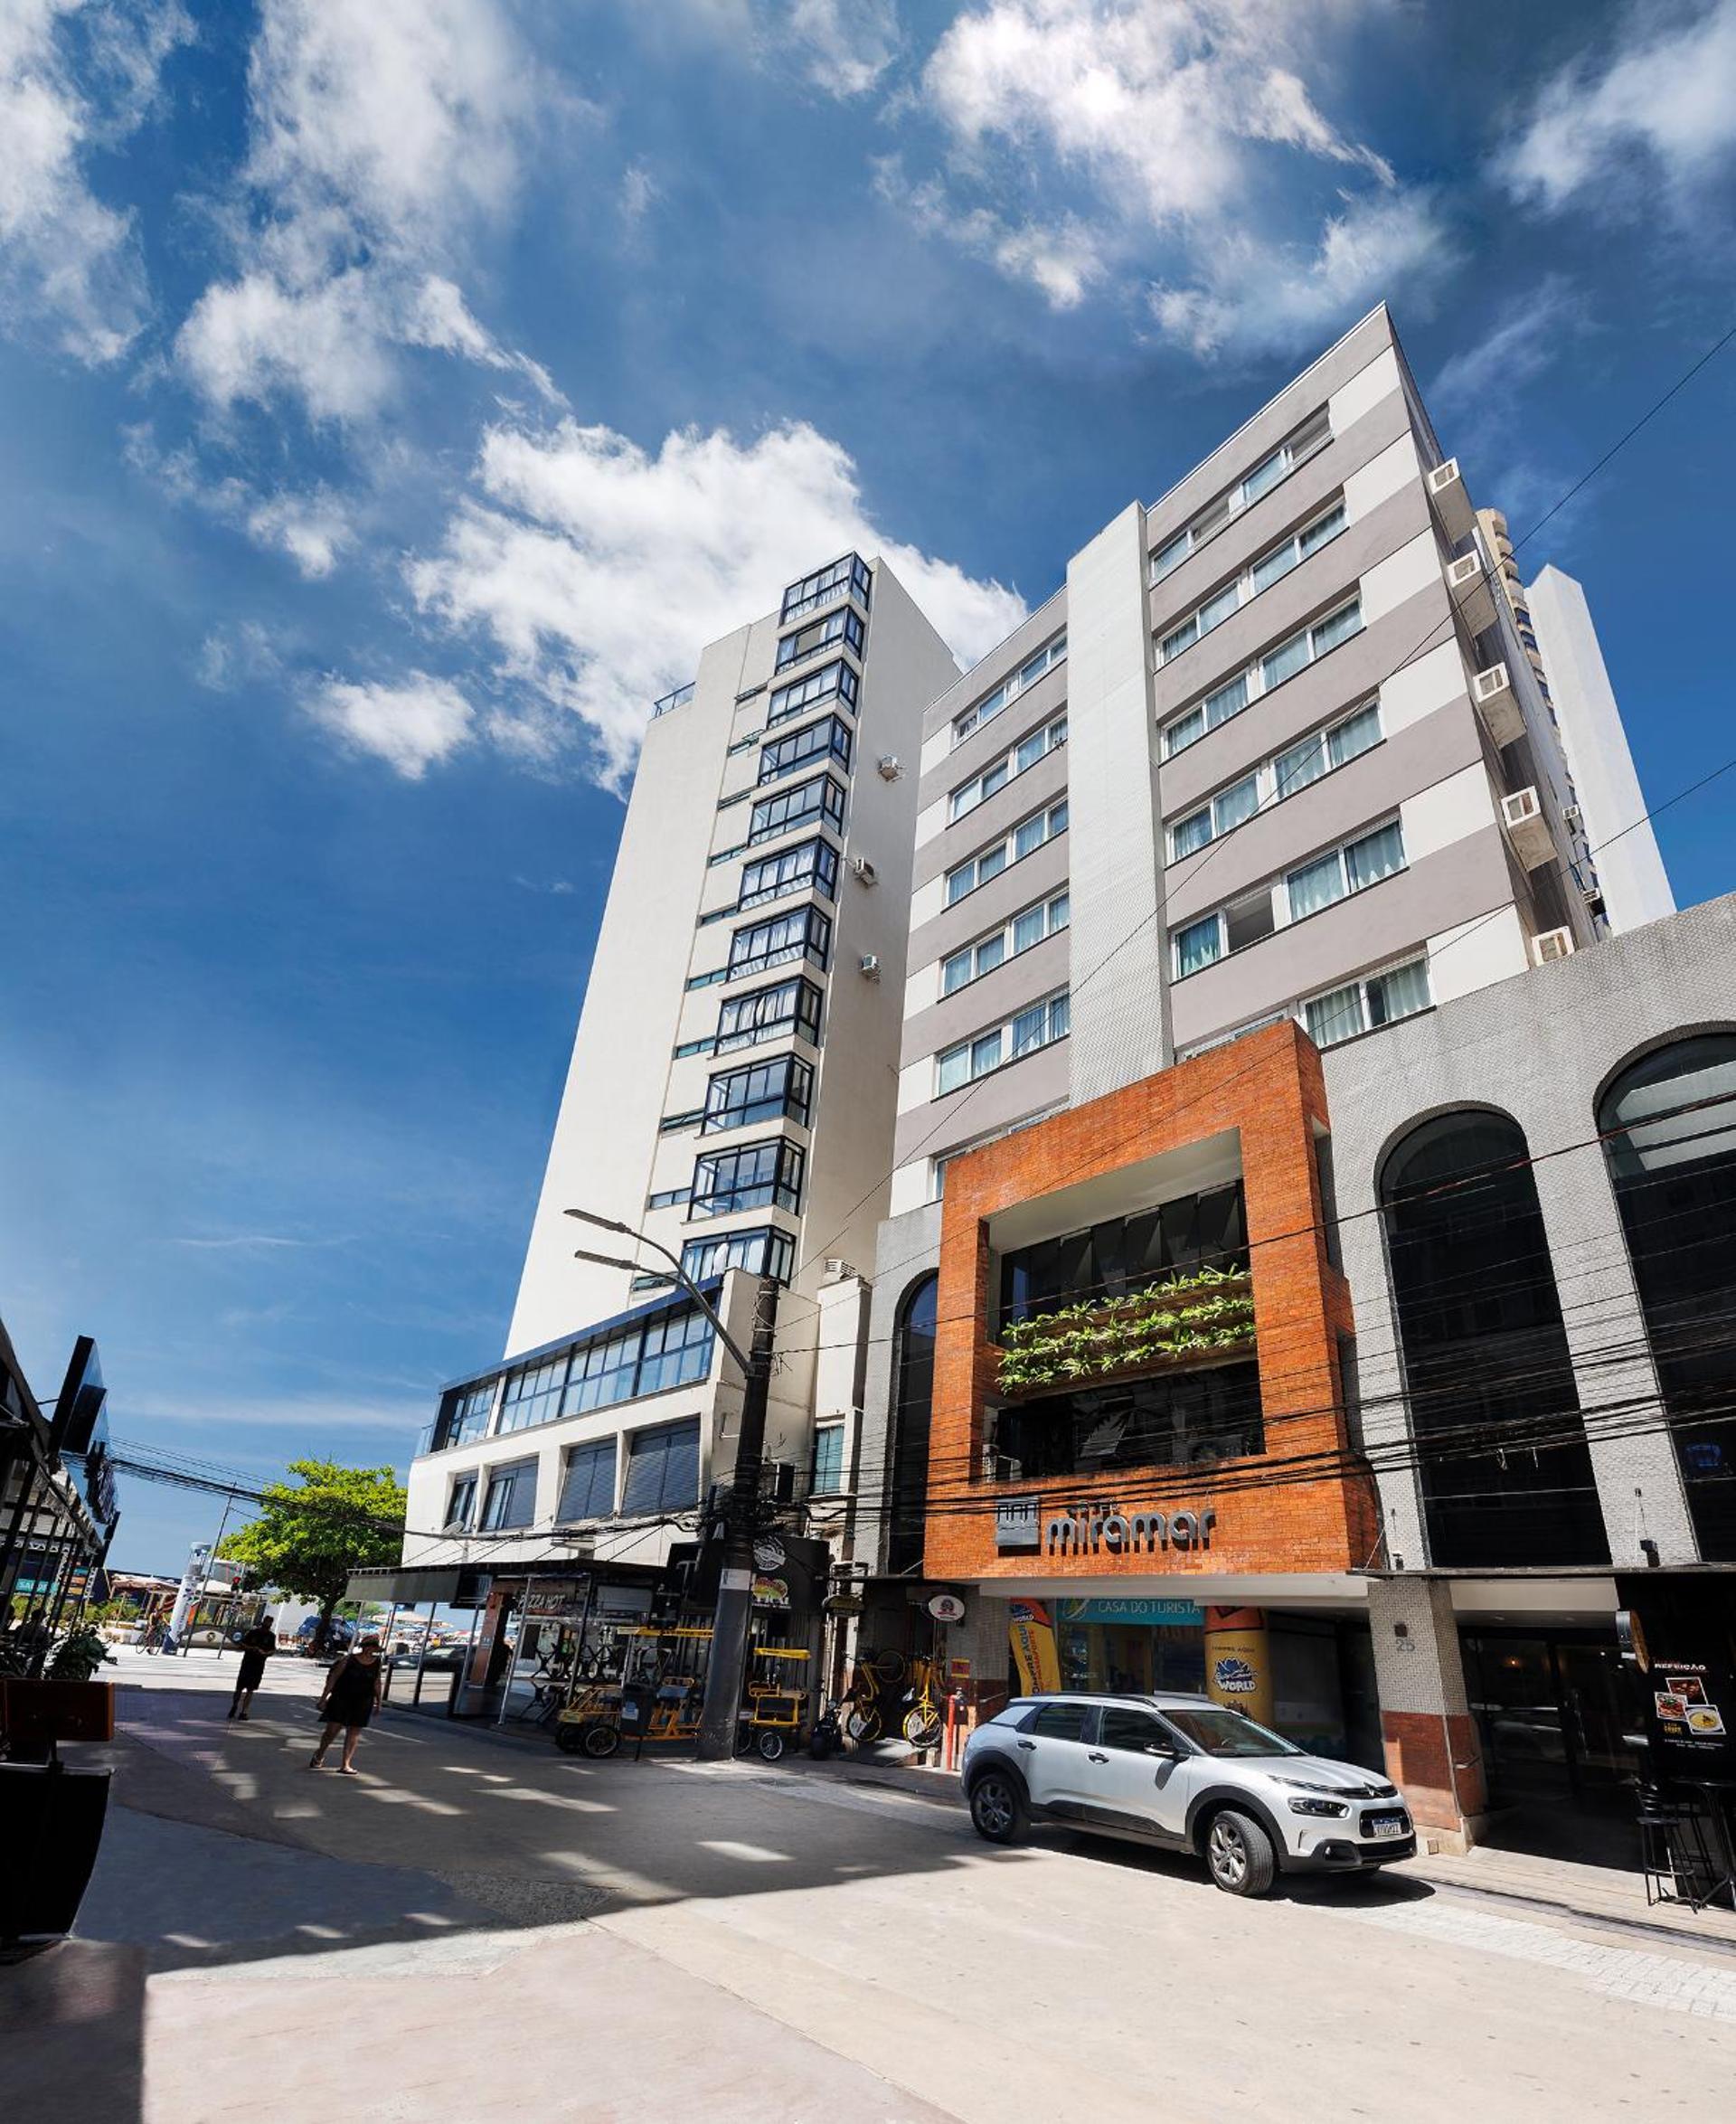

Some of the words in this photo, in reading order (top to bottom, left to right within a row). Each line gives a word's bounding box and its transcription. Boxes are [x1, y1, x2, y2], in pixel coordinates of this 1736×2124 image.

[1046, 1508, 1216, 1544] miramar
[1098, 1600, 1127, 1613] CASA
[1130, 1600, 1147, 1614] DO
[1150, 1600, 1201, 1614] TURISTA
[1217, 1679, 1257, 1693] WORLD
